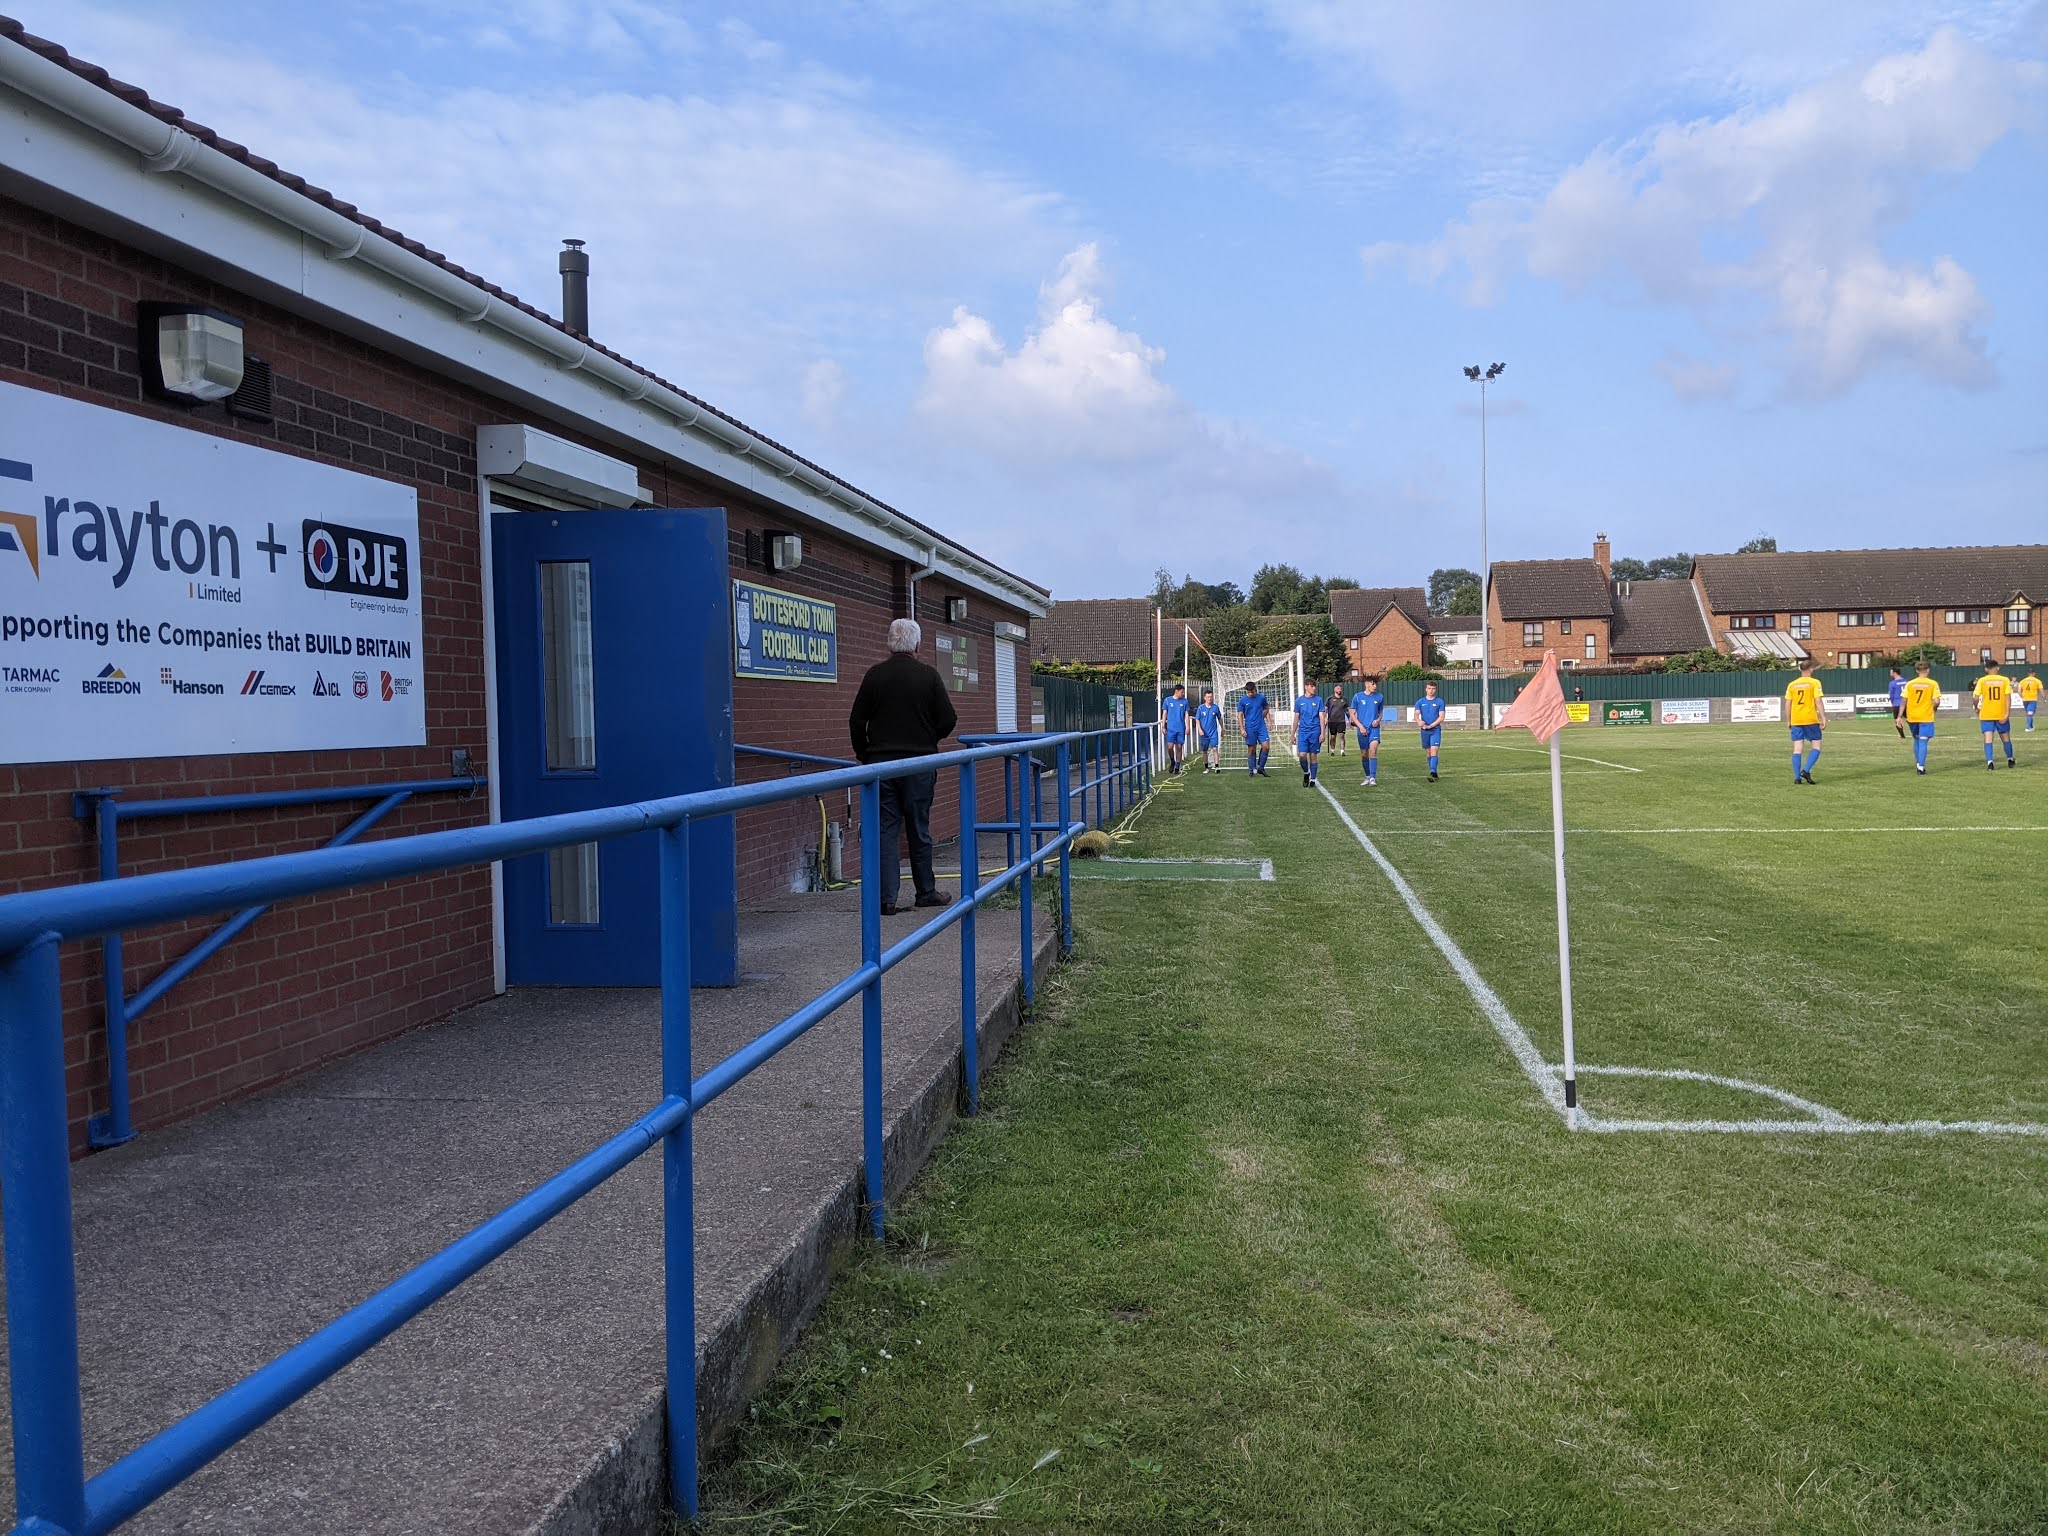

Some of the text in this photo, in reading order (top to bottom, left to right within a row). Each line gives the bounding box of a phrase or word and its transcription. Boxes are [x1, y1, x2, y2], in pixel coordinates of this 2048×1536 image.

[347, 537, 399, 589] RJE
[197, 583, 242, 603] Limited
[350, 598, 409, 616] Engineering Industry
[752, 591, 834, 634] BOTTESFORD TOWN
[116, 618, 151, 644] the
[158, 621, 262, 652] Companies
[267, 630, 301, 653] that
[305, 632, 352, 656] BUILD
[356, 637, 411, 659] BRITAIN
[762, 628, 807, 662] FOOTBALL
[808, 636, 829, 665] CLUB
[2, 667, 61, 682] TARMAC
[23, 686, 52, 694] COMPANY
[82, 680, 141, 694] BREEDON
[173, 679, 224, 695] Hanson
[259, 684, 296, 696] CEMEX
[328, 682, 342, 696] ICL
[355, 682, 366, 694] 66
[394, 678, 413, 687] BRITISH
[394, 686, 409, 695] STEEL
[1797, 690, 1805, 705] 2
[1915, 690, 1923, 704] 7
[1988, 686, 2001, 701] 10
